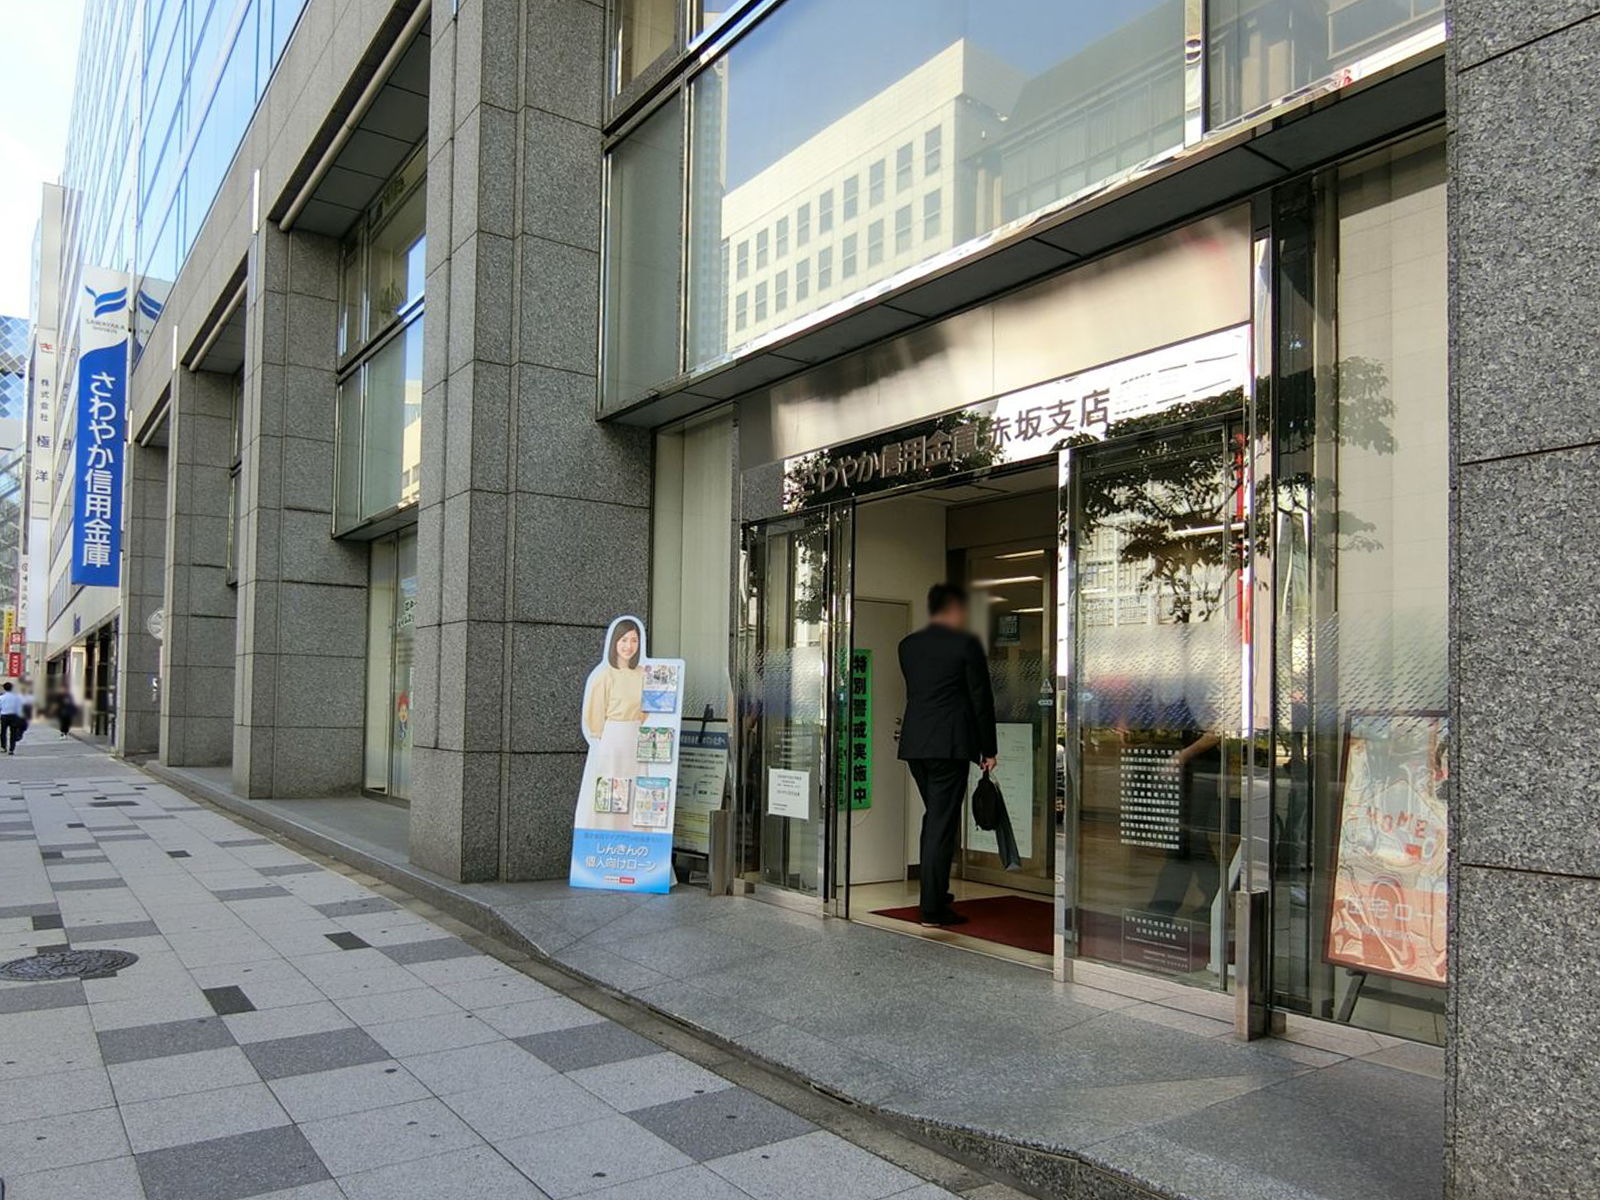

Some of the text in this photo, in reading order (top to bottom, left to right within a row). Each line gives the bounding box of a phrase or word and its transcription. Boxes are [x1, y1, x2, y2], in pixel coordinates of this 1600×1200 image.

[987, 388, 1111, 448] 赤坂支店
[81, 371, 117, 569] さわやか信用金庫
[852, 655, 868, 803] 特別警戒実施中
[585, 855, 657, 872] 個人向けローン
[596, 842, 649, 857] しんきんの
